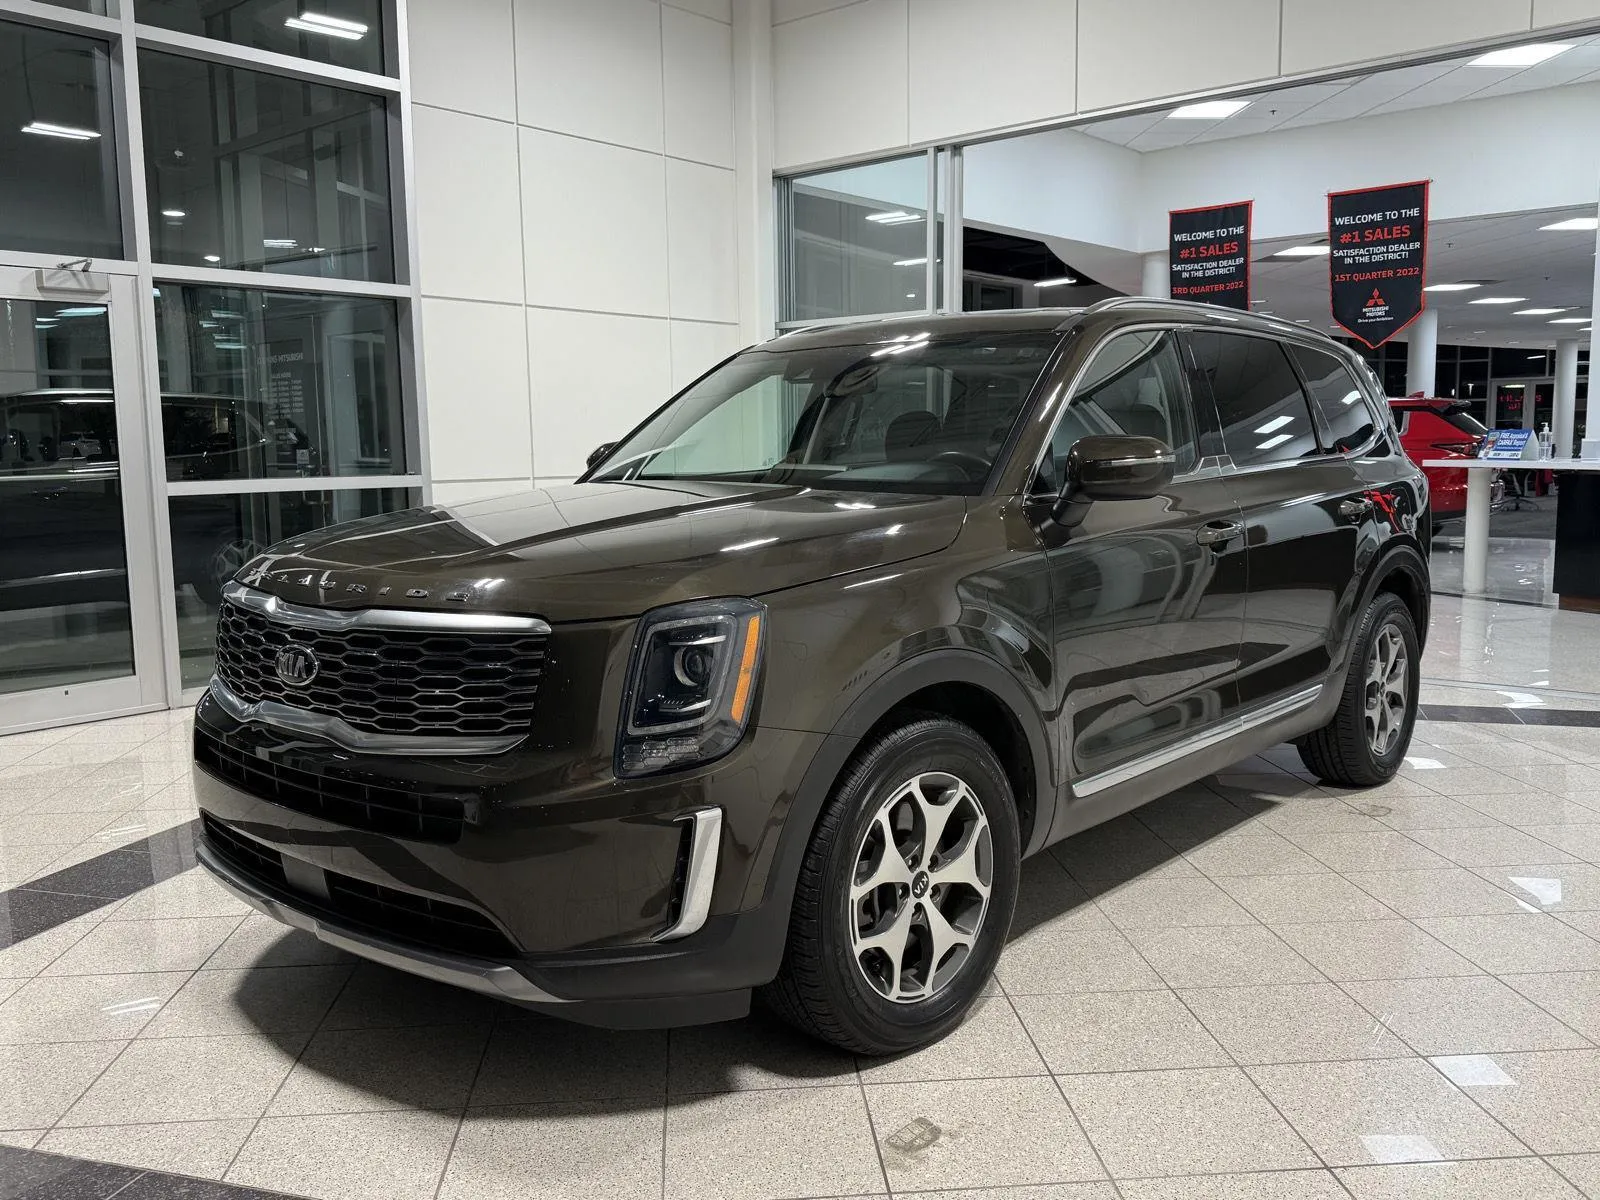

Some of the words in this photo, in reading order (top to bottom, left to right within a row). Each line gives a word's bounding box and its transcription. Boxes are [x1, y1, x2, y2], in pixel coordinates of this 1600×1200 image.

[1335, 213, 1383, 225] WELCOME
[1385, 211, 1398, 220] TO
[1400, 207, 1420, 218] THE
[1174, 230, 1215, 241] WELCOME
[1216, 228, 1227, 237] TO
[1228, 225, 1245, 235] THE
[1339, 231, 1361, 243] #1
[1364, 225, 1411, 241] SALES
[1180, 247, 1197, 258] #1
[1199, 241, 1239, 257] SALES
[1333, 246, 1387, 257] SATISFACTION
[1388, 242, 1420, 251] DEALER
[1172, 261, 1217, 271] SATISFACTION
[1219, 257, 1244, 267] DEALER
[1354, 256, 1370, 264] THE
[1371, 252, 1409, 262] DISTRICT!
[1205, 266, 1236, 276] DISTRICT!
[1335, 273, 1352, 282] 1ST
[1353, 270, 1393, 282] QUARTER
[1396, 267, 1419, 276] 2022
[1190, 284, 1224, 294] QUARTER
[1226, 281, 1244, 290] 2022
[277, 651, 308, 679] KIA
